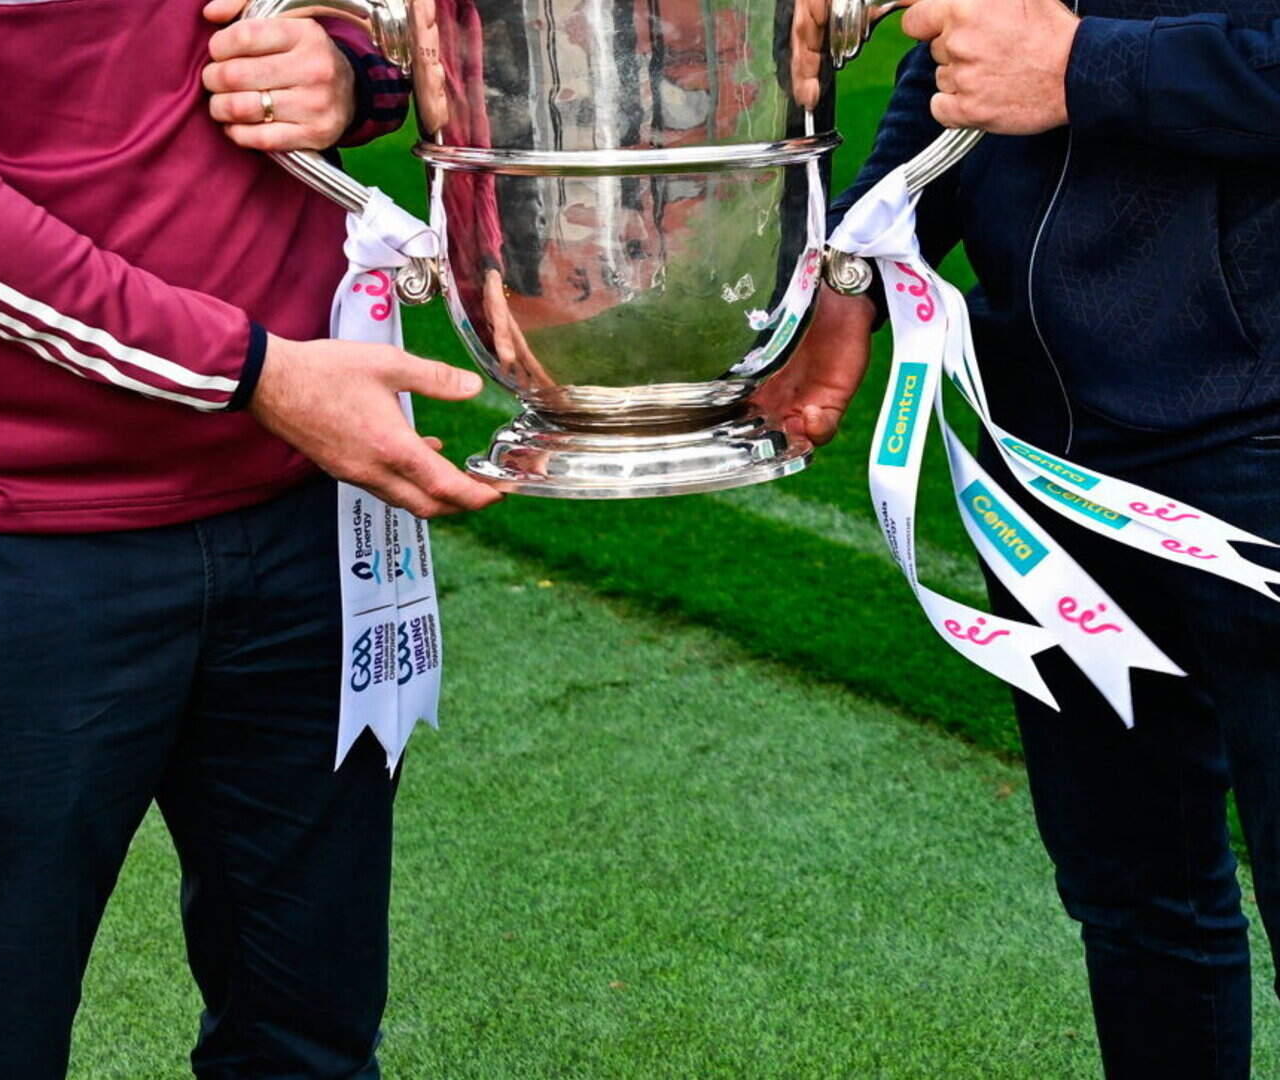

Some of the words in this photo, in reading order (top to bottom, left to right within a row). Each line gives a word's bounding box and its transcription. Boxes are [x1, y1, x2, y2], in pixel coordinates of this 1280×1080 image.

[887, 375, 918, 454] Centra
[1010, 444, 1086, 483] Centra
[352, 498, 362, 526] Gáis
[363, 513, 373, 557] Energy
[972, 495, 1033, 559] Centra
[353, 527, 364, 558] Bord
[373, 624, 384, 685] HURLING
[410, 618, 426, 675] HURLING
